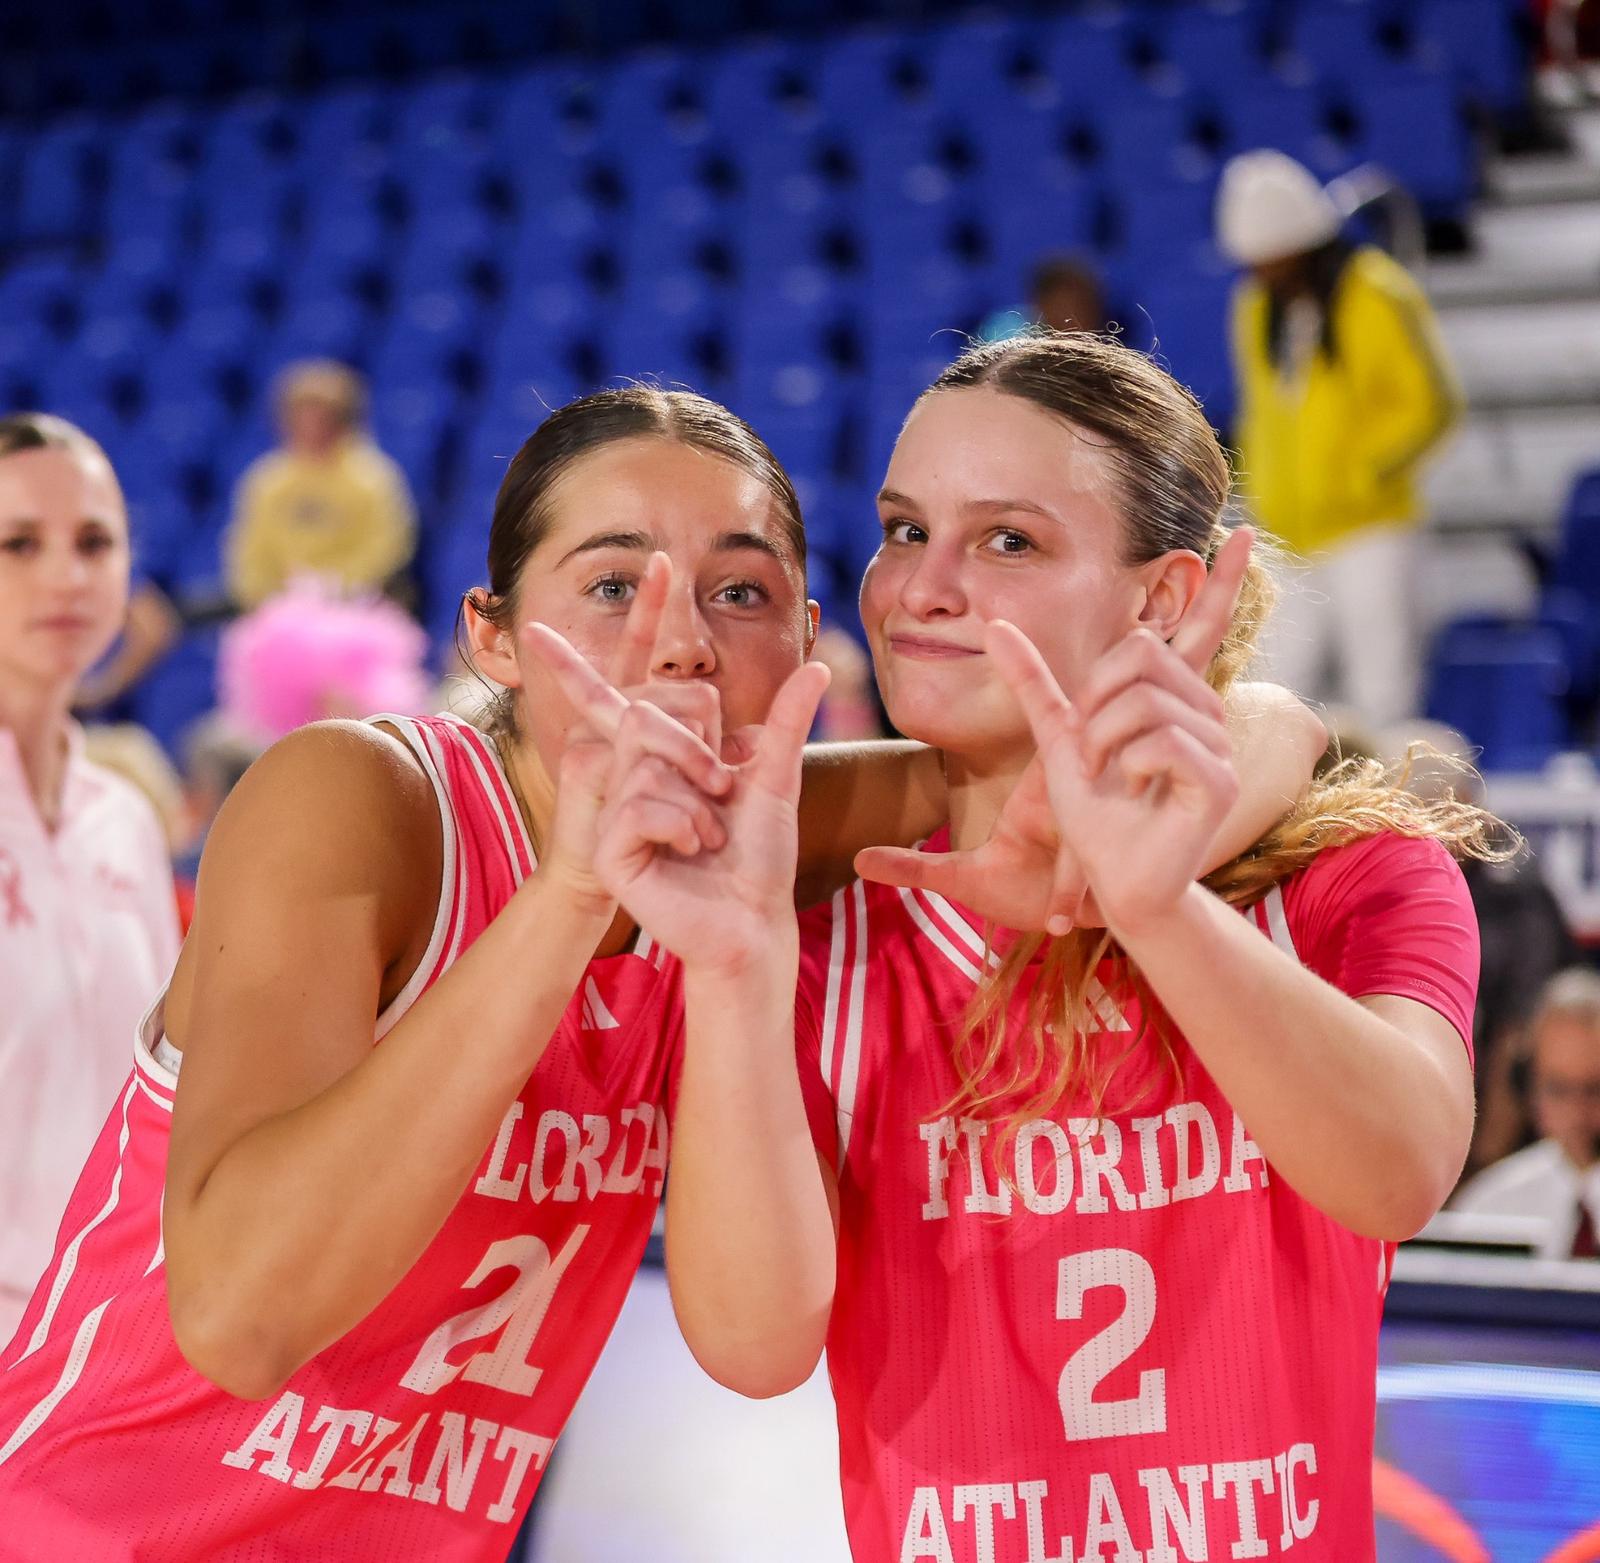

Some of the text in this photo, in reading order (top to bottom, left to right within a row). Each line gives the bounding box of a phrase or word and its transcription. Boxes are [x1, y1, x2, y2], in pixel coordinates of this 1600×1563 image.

[474, 1101, 668, 1204] LORDA
[919, 1101, 1270, 1220] FLORIDA
[399, 1224, 591, 1397] 21
[1056, 1248, 1167, 1441] 2
[221, 1390, 556, 1524] ATLANT
[899, 1442, 1320, 1563] ATLANTIC
